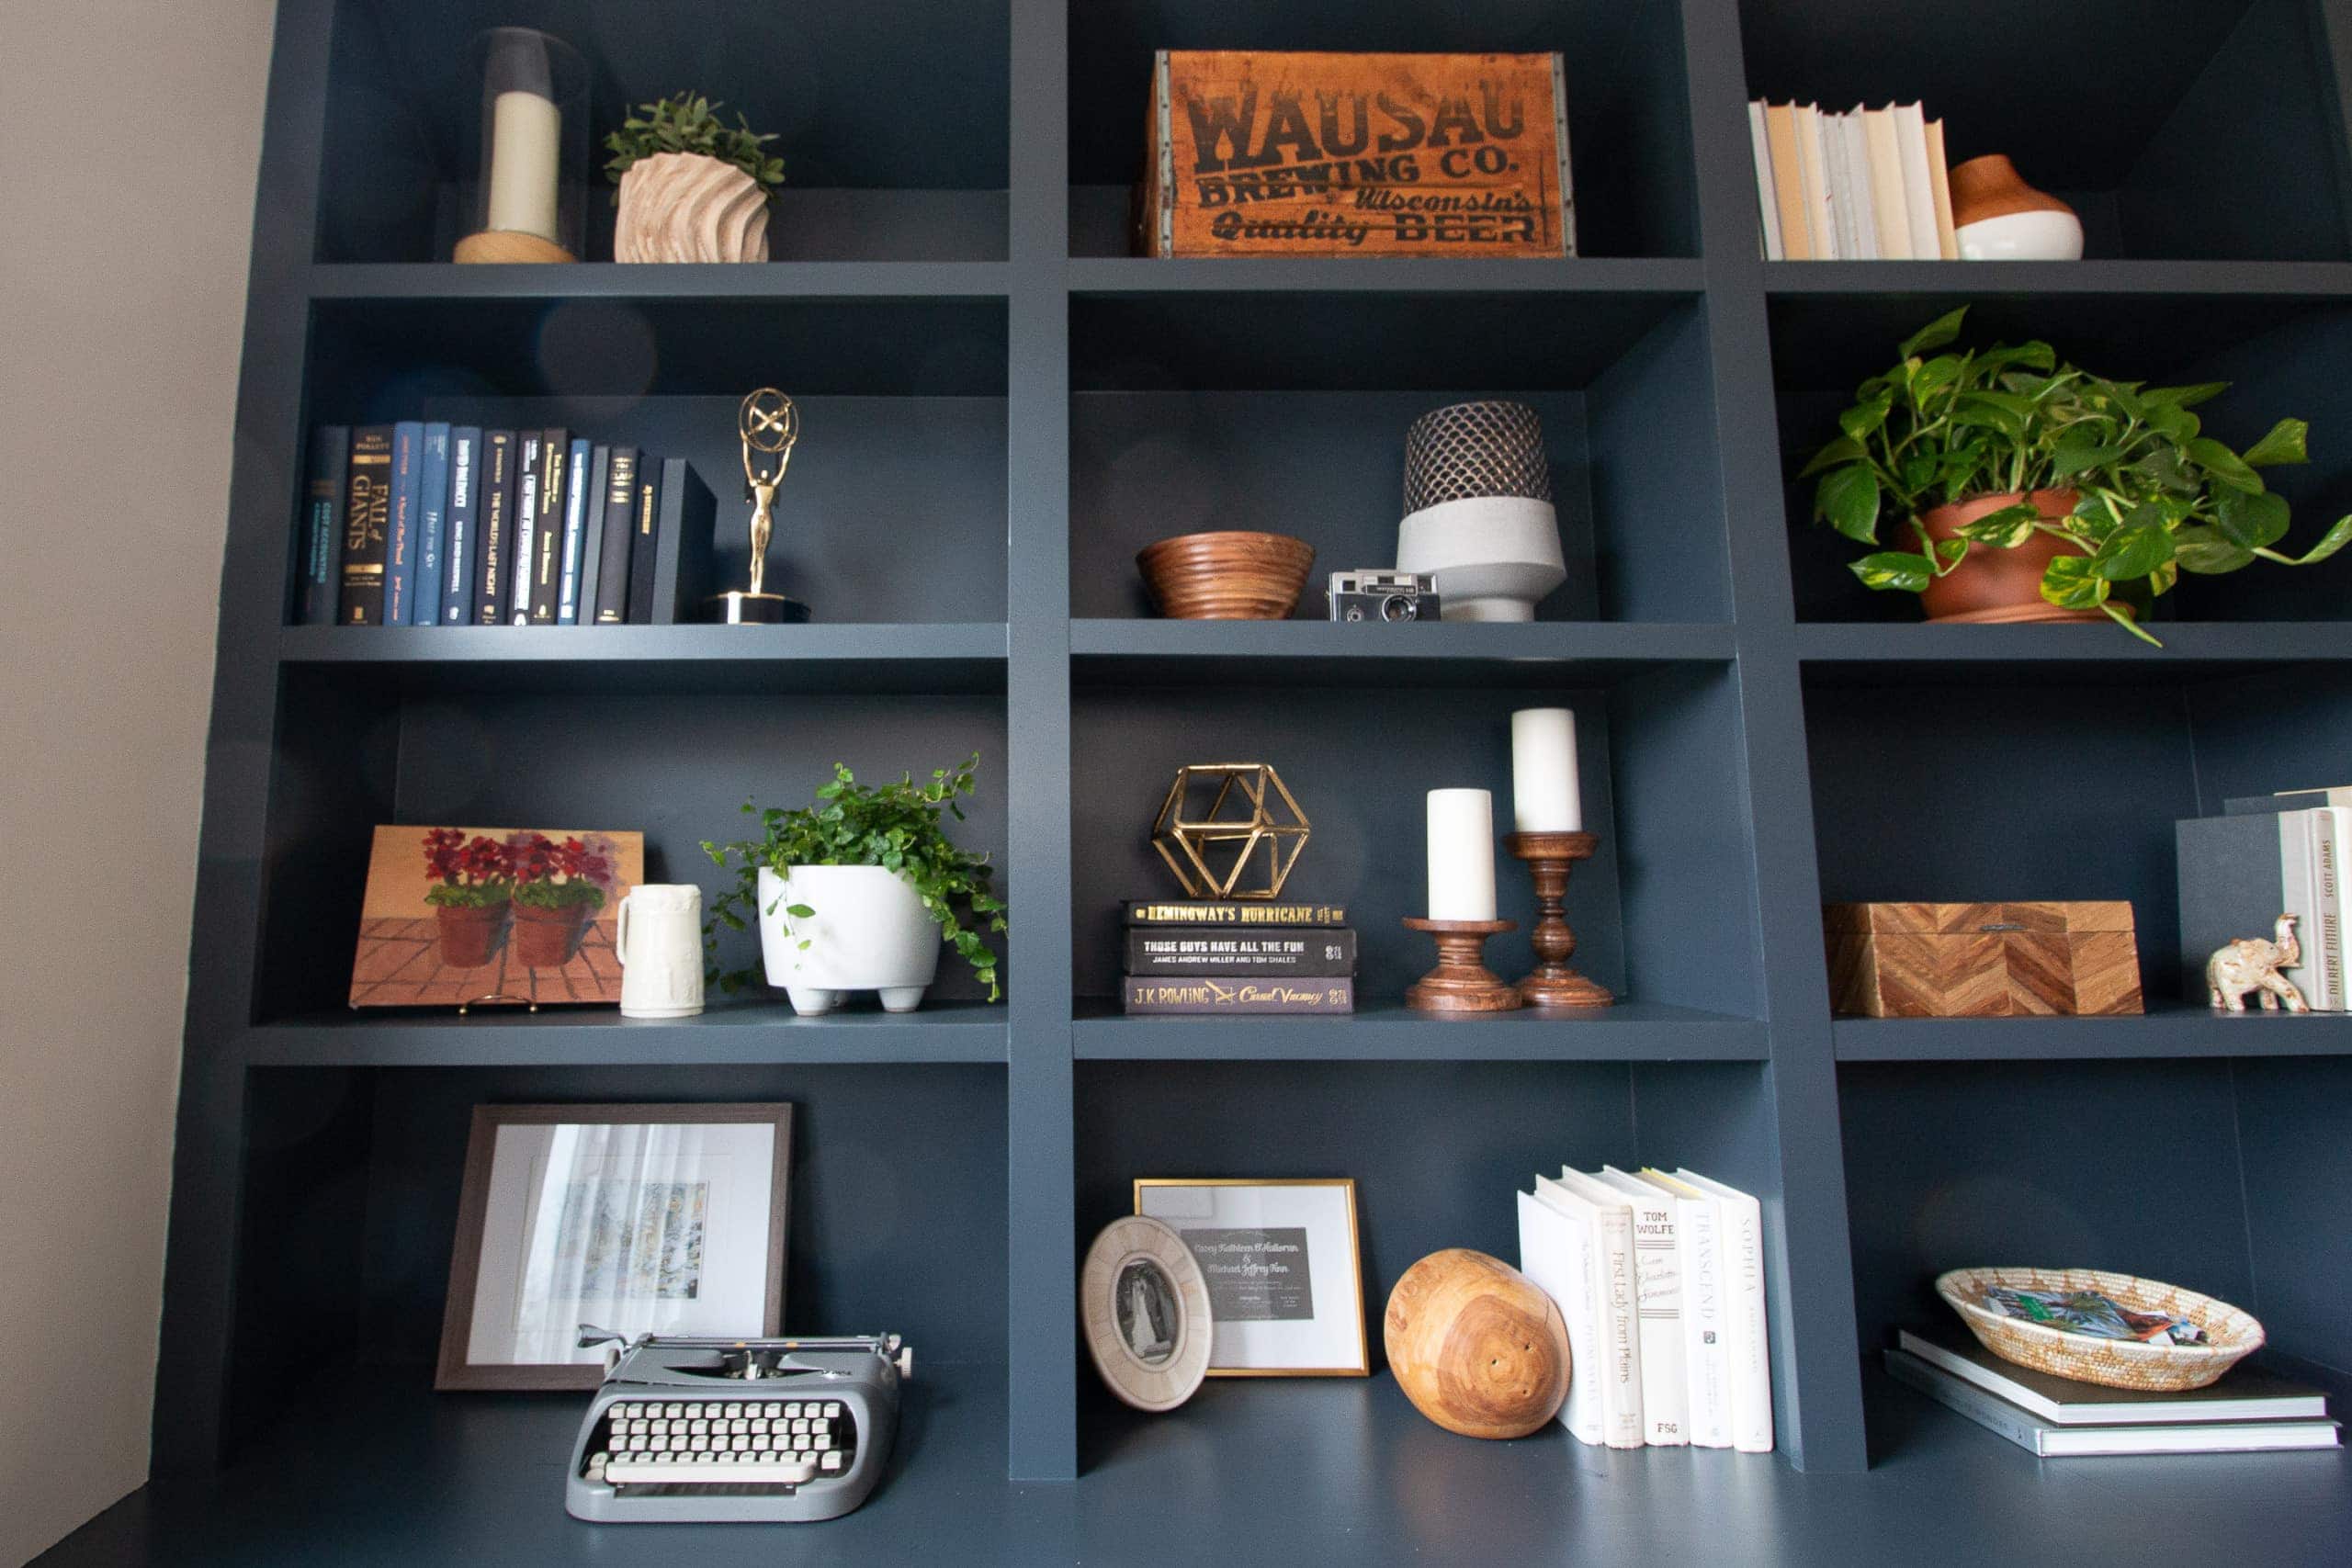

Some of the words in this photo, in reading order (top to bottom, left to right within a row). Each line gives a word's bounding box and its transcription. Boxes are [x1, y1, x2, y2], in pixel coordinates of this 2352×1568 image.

[1182, 81, 1525, 175] WAUSAU
[1196, 155, 1420, 209] BREWING
[1440, 144, 1520, 179] CO.
[1354, 186, 1532, 212] Wisconsin's
[1211, 209, 1370, 246] Quality
[1395, 214, 1536, 243] BEER
[347, 474, 371, 550] GIANTS
[371, 484, 389, 529] FALL
[368, 529, 382, 542] of
[2322, 839, 2333, 870] ADAMS
[2324, 872, 2335, 898] SCOTT
[1147, 906, 1236, 922] HEMINGWAY'S
[1241, 907, 1313, 922] HURRICANE
[1144, 942, 1177, 953] THOSE
[1180, 942, 1208, 953] GUYS
[1210, 942, 1238, 953] HAVE
[1240, 942, 1259, 953] ALL
[1261, 942, 1281, 953] THE
[1283, 942, 1305, 953] FUN
[1236, 955, 1251, 964] AND
[1252, 955, 1267, 964] TOM
[1268, 955, 1296, 964] SHALES
[1159, 987, 1210, 1004] ROWLING
[1636, 1224, 1674, 1235] WOLFE
[1643, 1212, 1668, 1222] TOM
[1612, 1251, 1626, 1279] First
[1695, 1212, 1717, 1321] TRANSCEND
[1740, 1218, 1758, 1293] SOPHIA
[1610, 1281, 1629, 1312] Lady
[1615, 1315, 1630, 1344] from
[1618, 1348, 1633, 1384] Plains
[1657, 1423, 1678, 1434] FSG
